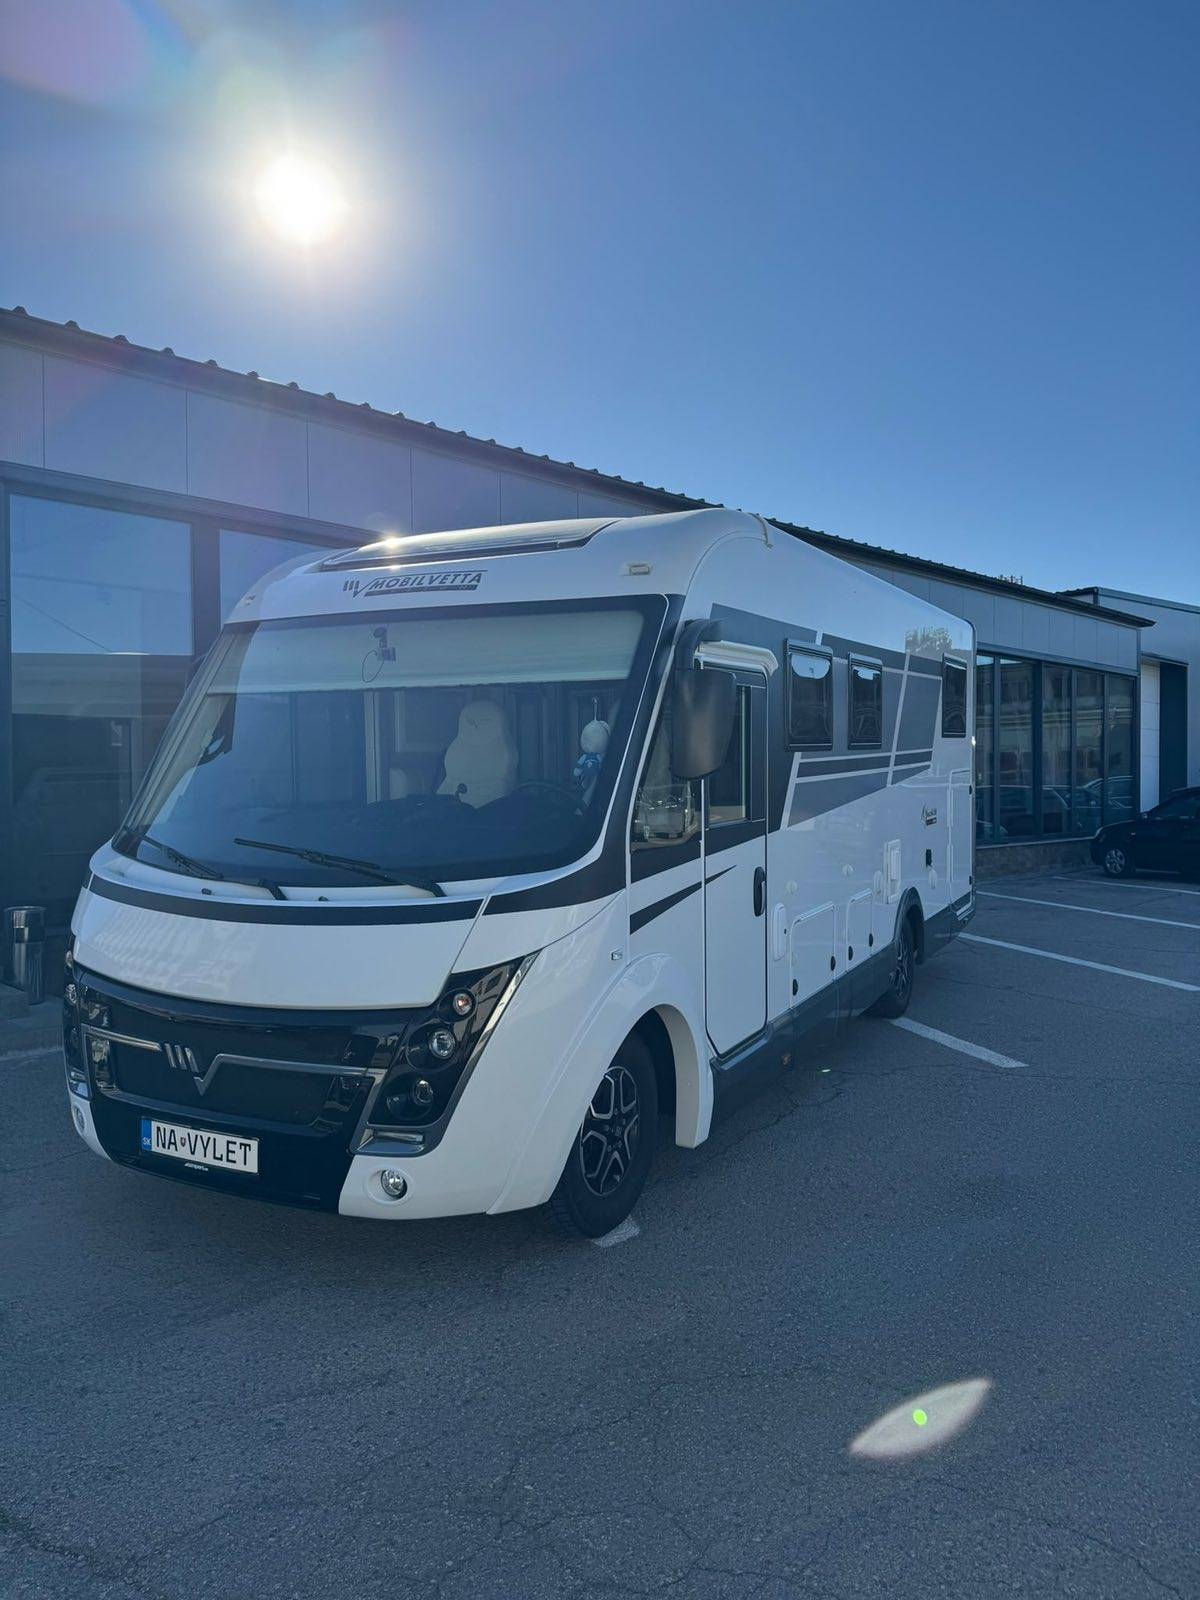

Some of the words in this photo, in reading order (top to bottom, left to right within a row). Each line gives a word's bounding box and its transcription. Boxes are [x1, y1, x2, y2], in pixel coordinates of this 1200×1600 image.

[368, 572, 482, 590] MOBILVETTA
[156, 1126, 178, 1152] NA
[187, 1132, 252, 1166] VYLET
